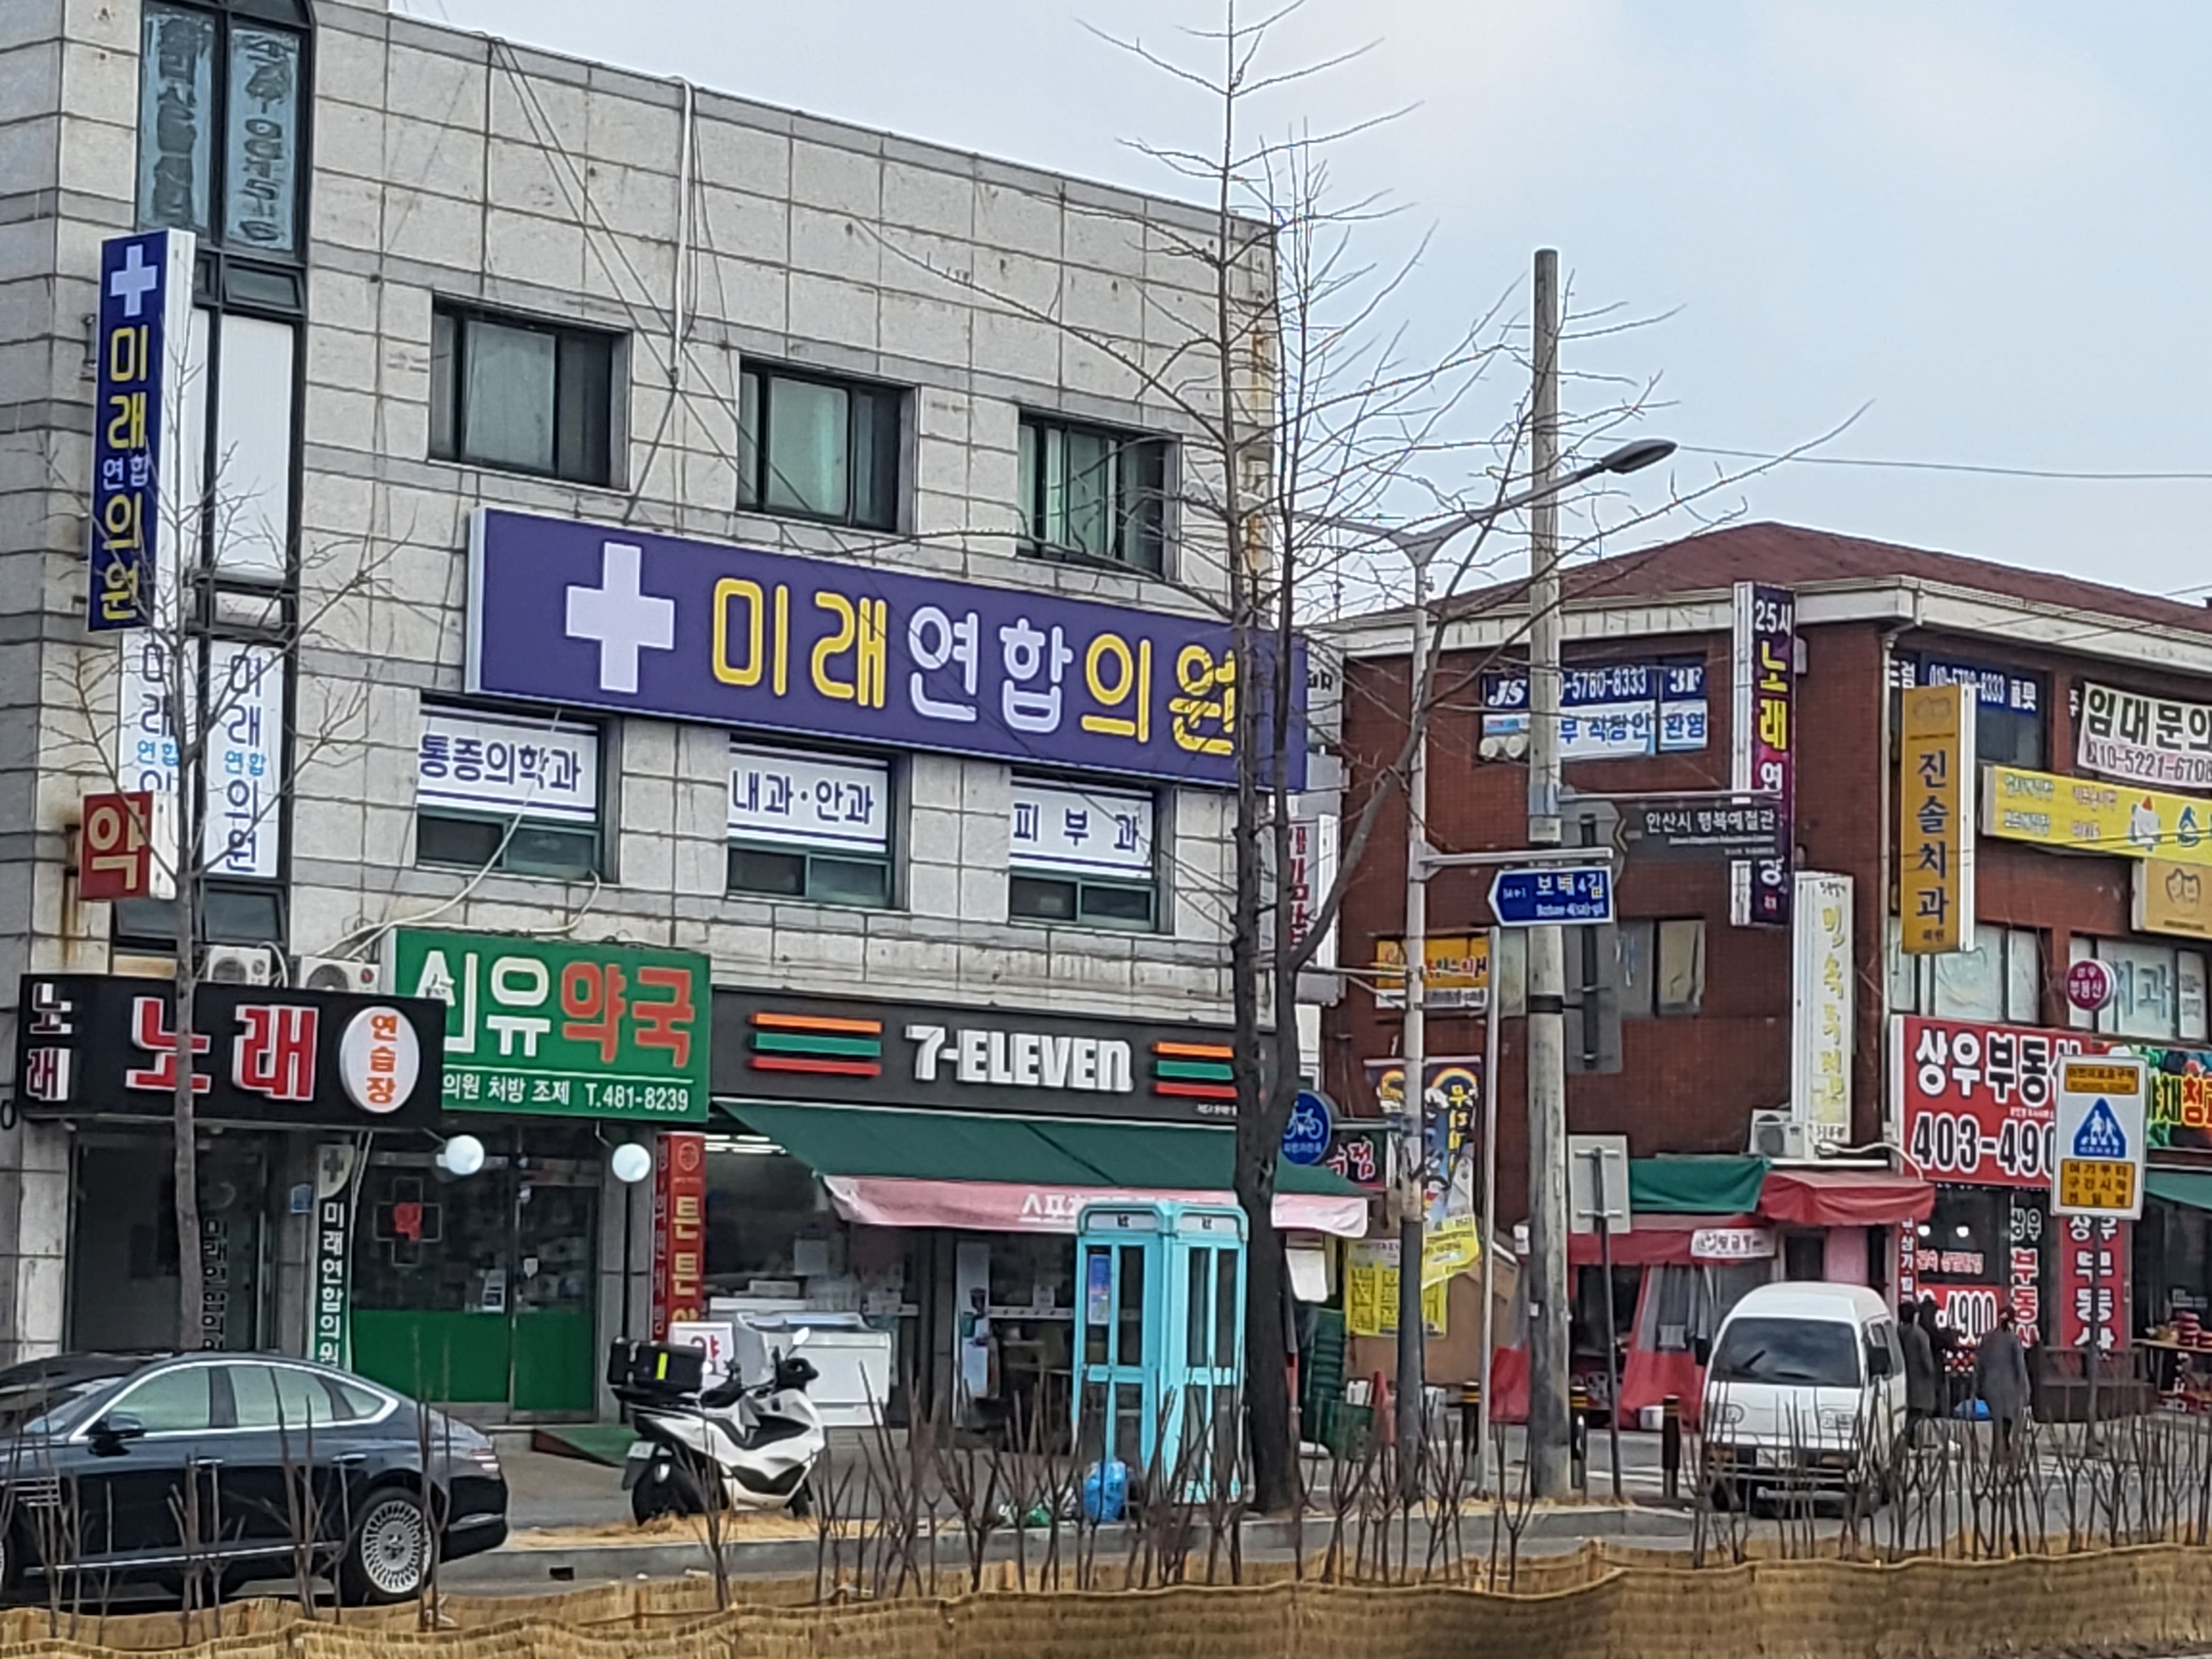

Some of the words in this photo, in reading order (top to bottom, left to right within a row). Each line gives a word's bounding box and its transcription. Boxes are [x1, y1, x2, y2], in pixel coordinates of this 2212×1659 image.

[100, 324, 150, 621] 미래연합의원
[1755, 602, 1792, 636] 25시
[713, 578, 1235, 755] 미래연합의원
[1488, 679, 1527, 706] JS
[1670, 667, 1703, 693] 3F
[1588, 712, 1651, 742] 직장인
[1665, 711, 1705, 740] 환영
[2089, 688, 2212, 753] 임대문의
[225, 655, 267, 872] 미래연합의원
[418, 735, 581, 792] 통증의학과
[732, 769, 875, 825] 내과·안과
[1013, 802, 1139, 853] 피부과
[1646, 811, 1692, 833] 안산시
[87, 800, 147, 890] 약
[1916, 750, 1950, 925] 진솔치과
[414, 950, 695, 1068] 신유약국
[126, 997, 319, 1102] 노래
[367, 1014, 398, 1103] 연습장
[442, 1072, 481, 1100] 의원
[487, 1076, 525, 1103] 처방
[531, 1079, 570, 1105] 조제
[585, 1082, 689, 1112] T.481-8239
[319, 1202, 345, 1368] 미래연합의원
